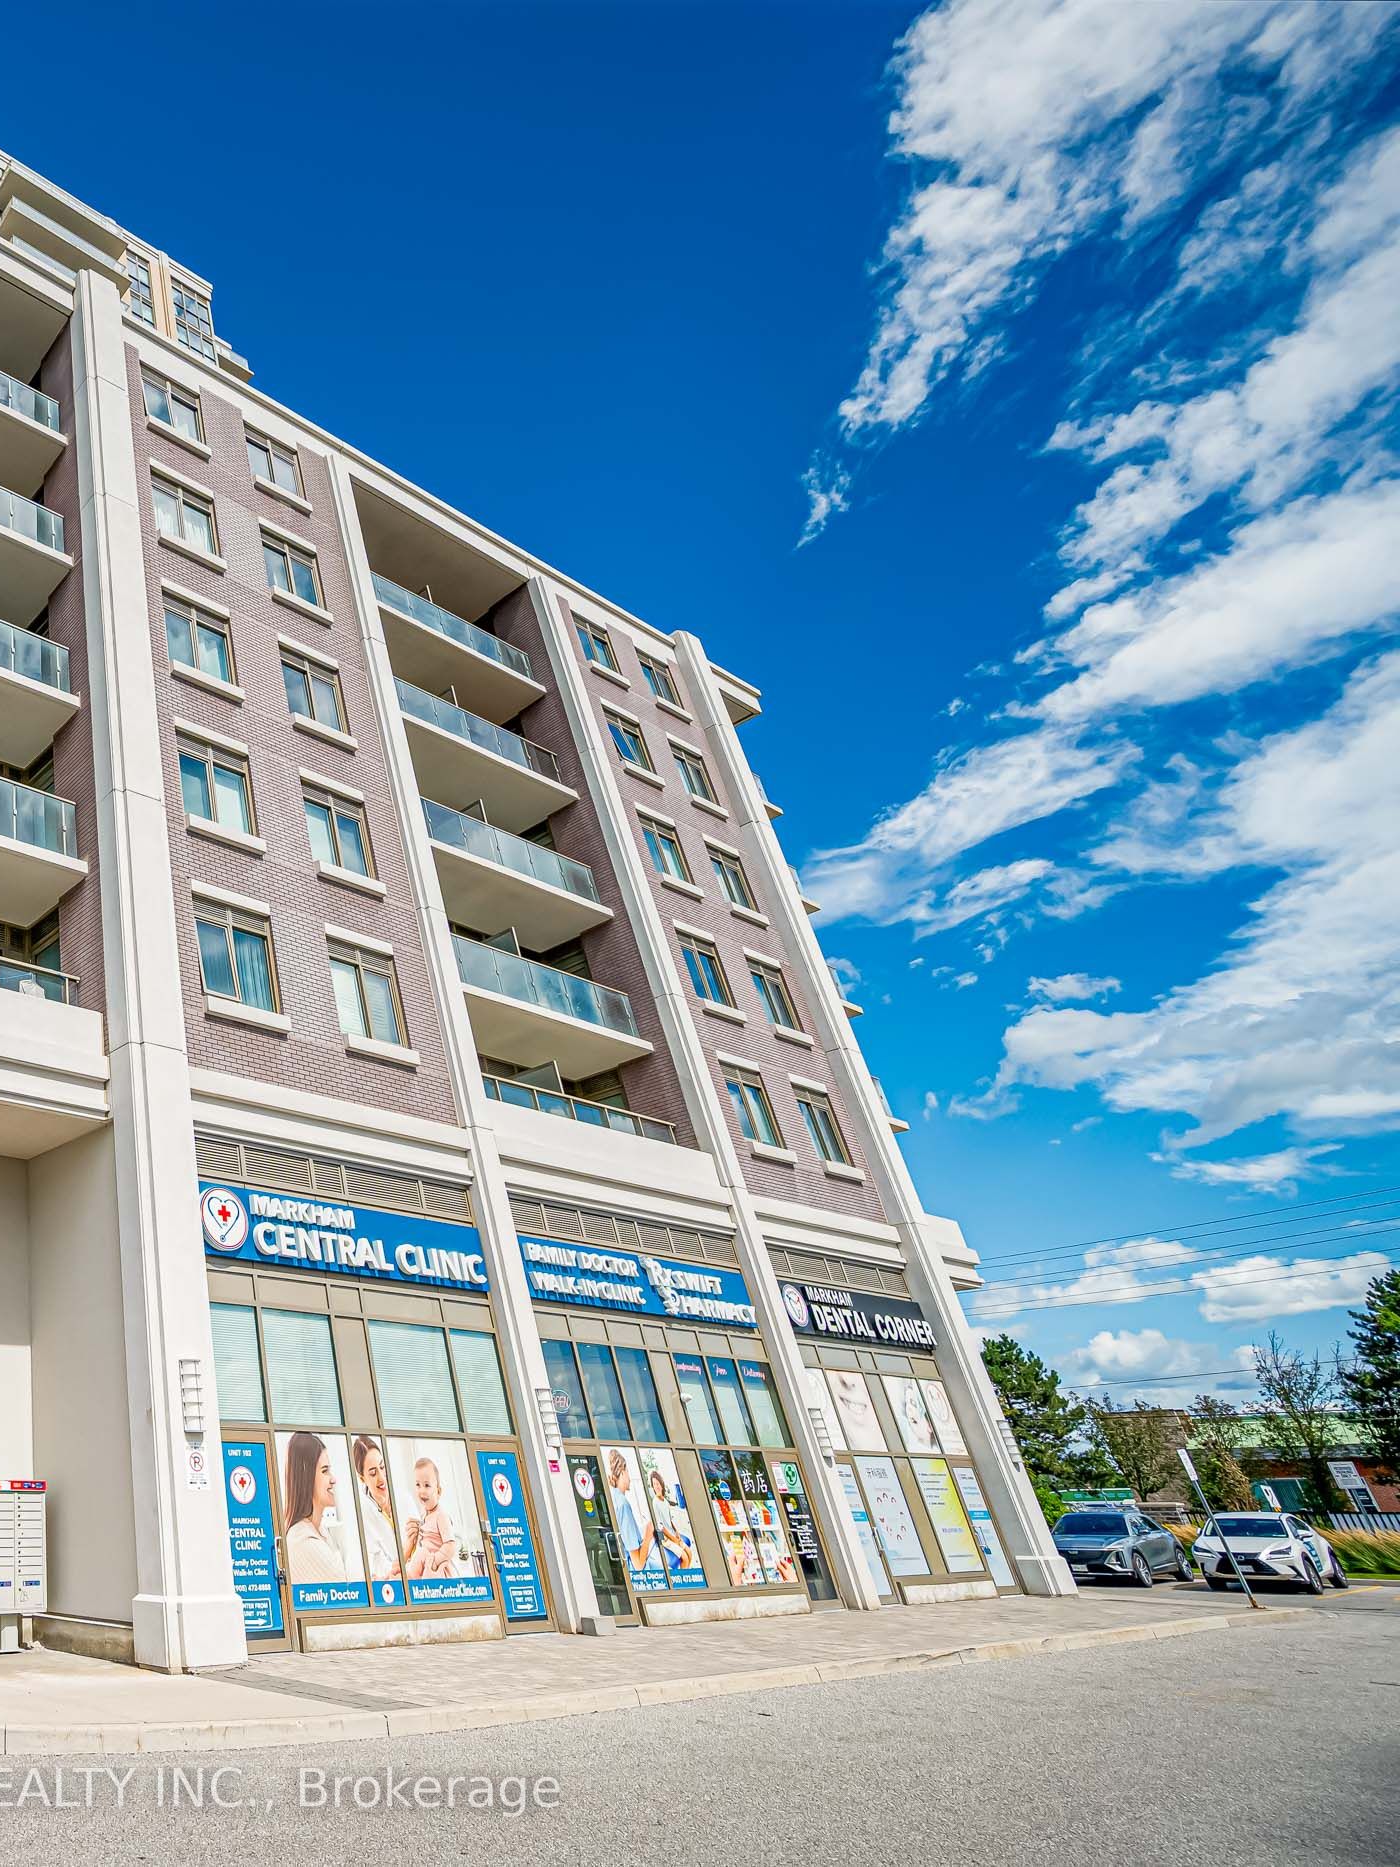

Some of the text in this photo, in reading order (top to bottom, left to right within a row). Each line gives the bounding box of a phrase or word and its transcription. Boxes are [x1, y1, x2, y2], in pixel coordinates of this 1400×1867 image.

[249, 1194, 355, 1229] MARKHAM
[253, 1222, 487, 1284] CENTRAL CLINIC
[523, 1243, 640, 1277] FAMILY DOCTOR
[529, 1272, 646, 1304] WALK-IN CLINIC
[804, 1286, 853, 1307] MARKHAM
[664, 1287, 756, 1324] PHARMACY
[810, 1303, 938, 1346] DENTAL CORNER
[228, 1449, 241, 1457] UNIT
[741, 1469, 768, 1494] 药店
[229, 1527, 266, 1539] CENTRAL
[497, 1526, 525, 1536] CENTRAL
[235, 1540, 262, 1551] CLINIC
[502, 1537, 522, 1546] CLINIC
[250, 1558, 268, 1566] Doctor
[646, 1572, 664, 1580] Doctor
[300, 1589, 359, 1604] Family Doctor
[412, 1584, 487, 1599] MarkhamCentralClinic.com
